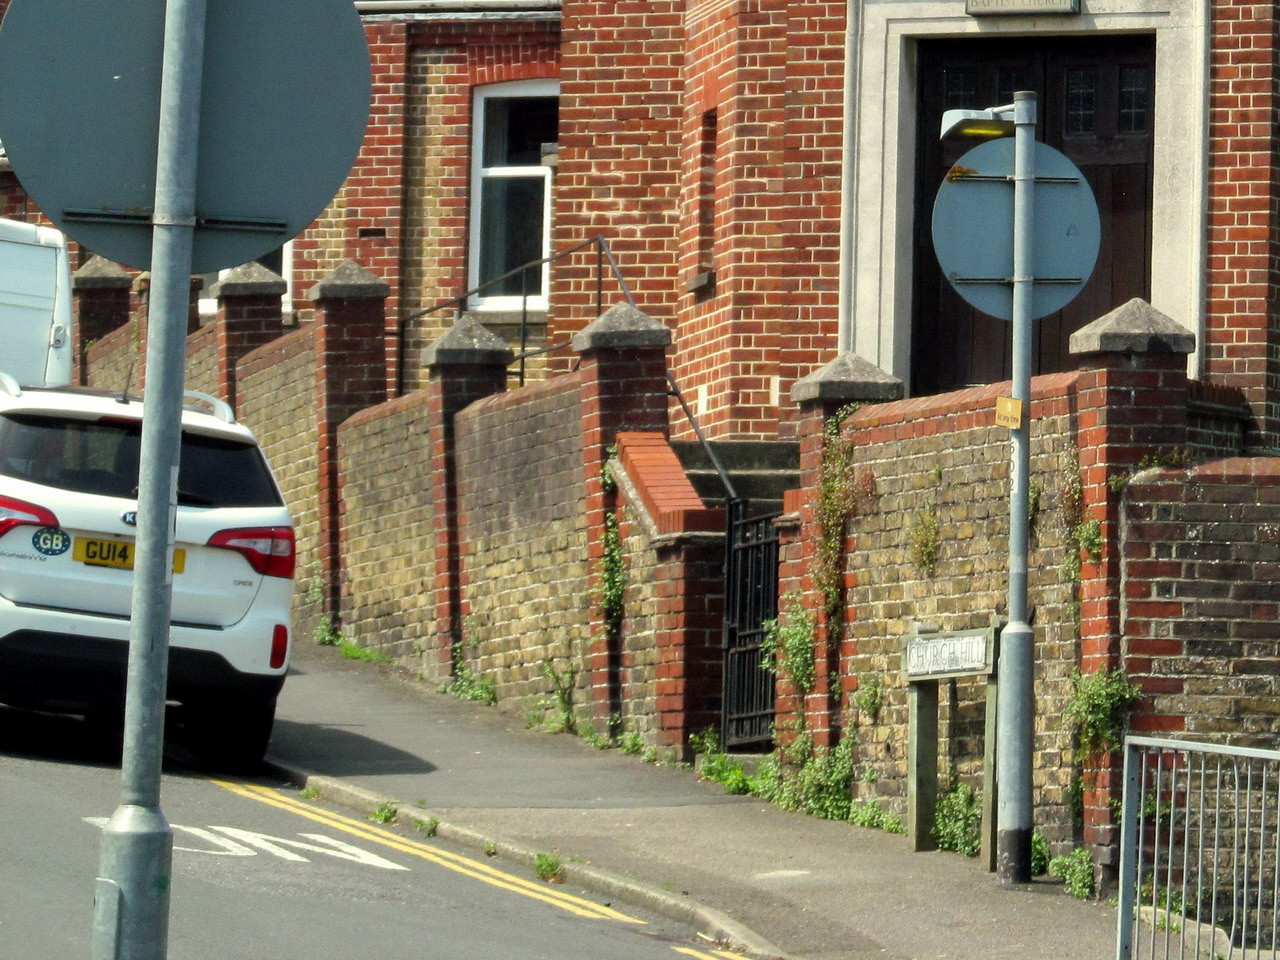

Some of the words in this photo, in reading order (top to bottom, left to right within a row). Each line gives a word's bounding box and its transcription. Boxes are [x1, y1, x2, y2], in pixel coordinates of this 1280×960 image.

[39, 534, 63, 550] GB
[86, 541, 129, 563] GU14
[909, 643, 956, 669] CHURCH
[960, 641, 983, 664] HILL
